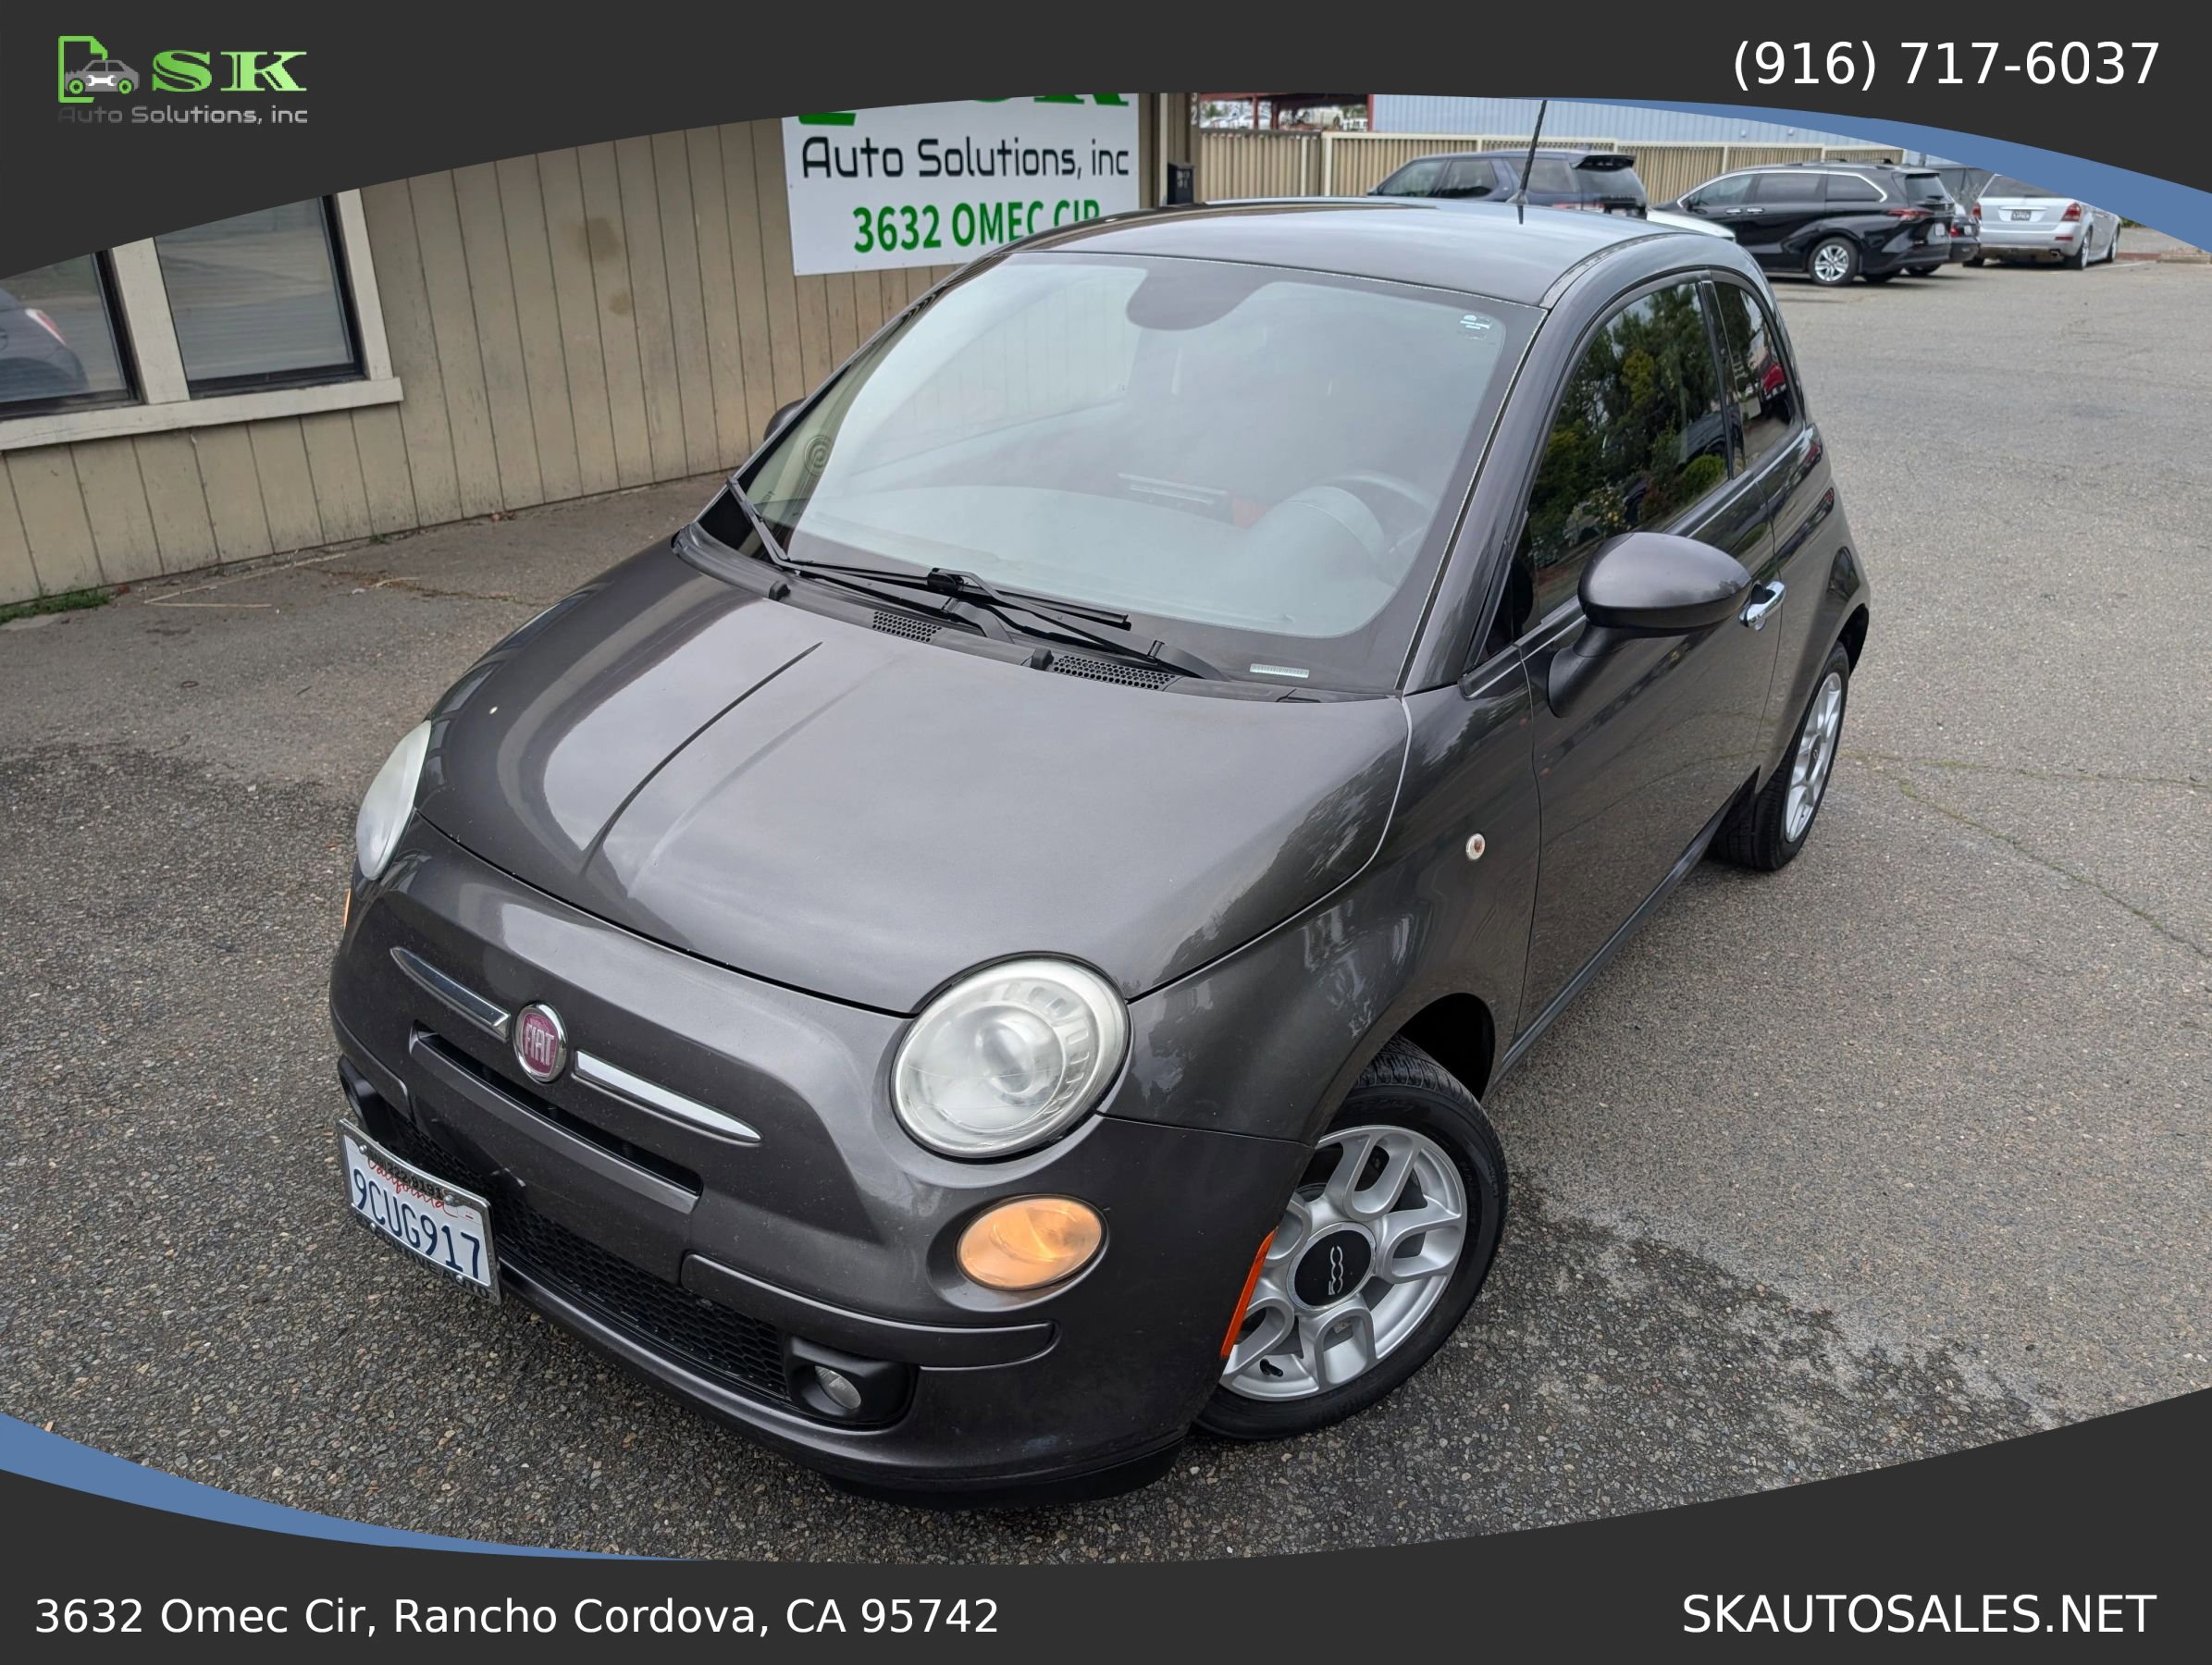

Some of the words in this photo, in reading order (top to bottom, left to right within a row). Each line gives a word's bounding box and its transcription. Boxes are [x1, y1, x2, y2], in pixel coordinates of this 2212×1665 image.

[802, 136, 904, 178] Auto
[918, 136, 1081, 180] Solutions,
[1092, 139, 1129, 176] inc
[853, 204, 942, 253] 3632
[952, 201, 1044, 247] OMEC
[525, 1022, 555, 1067] FIAT
[353, 1168, 480, 1279] 9CUG917
